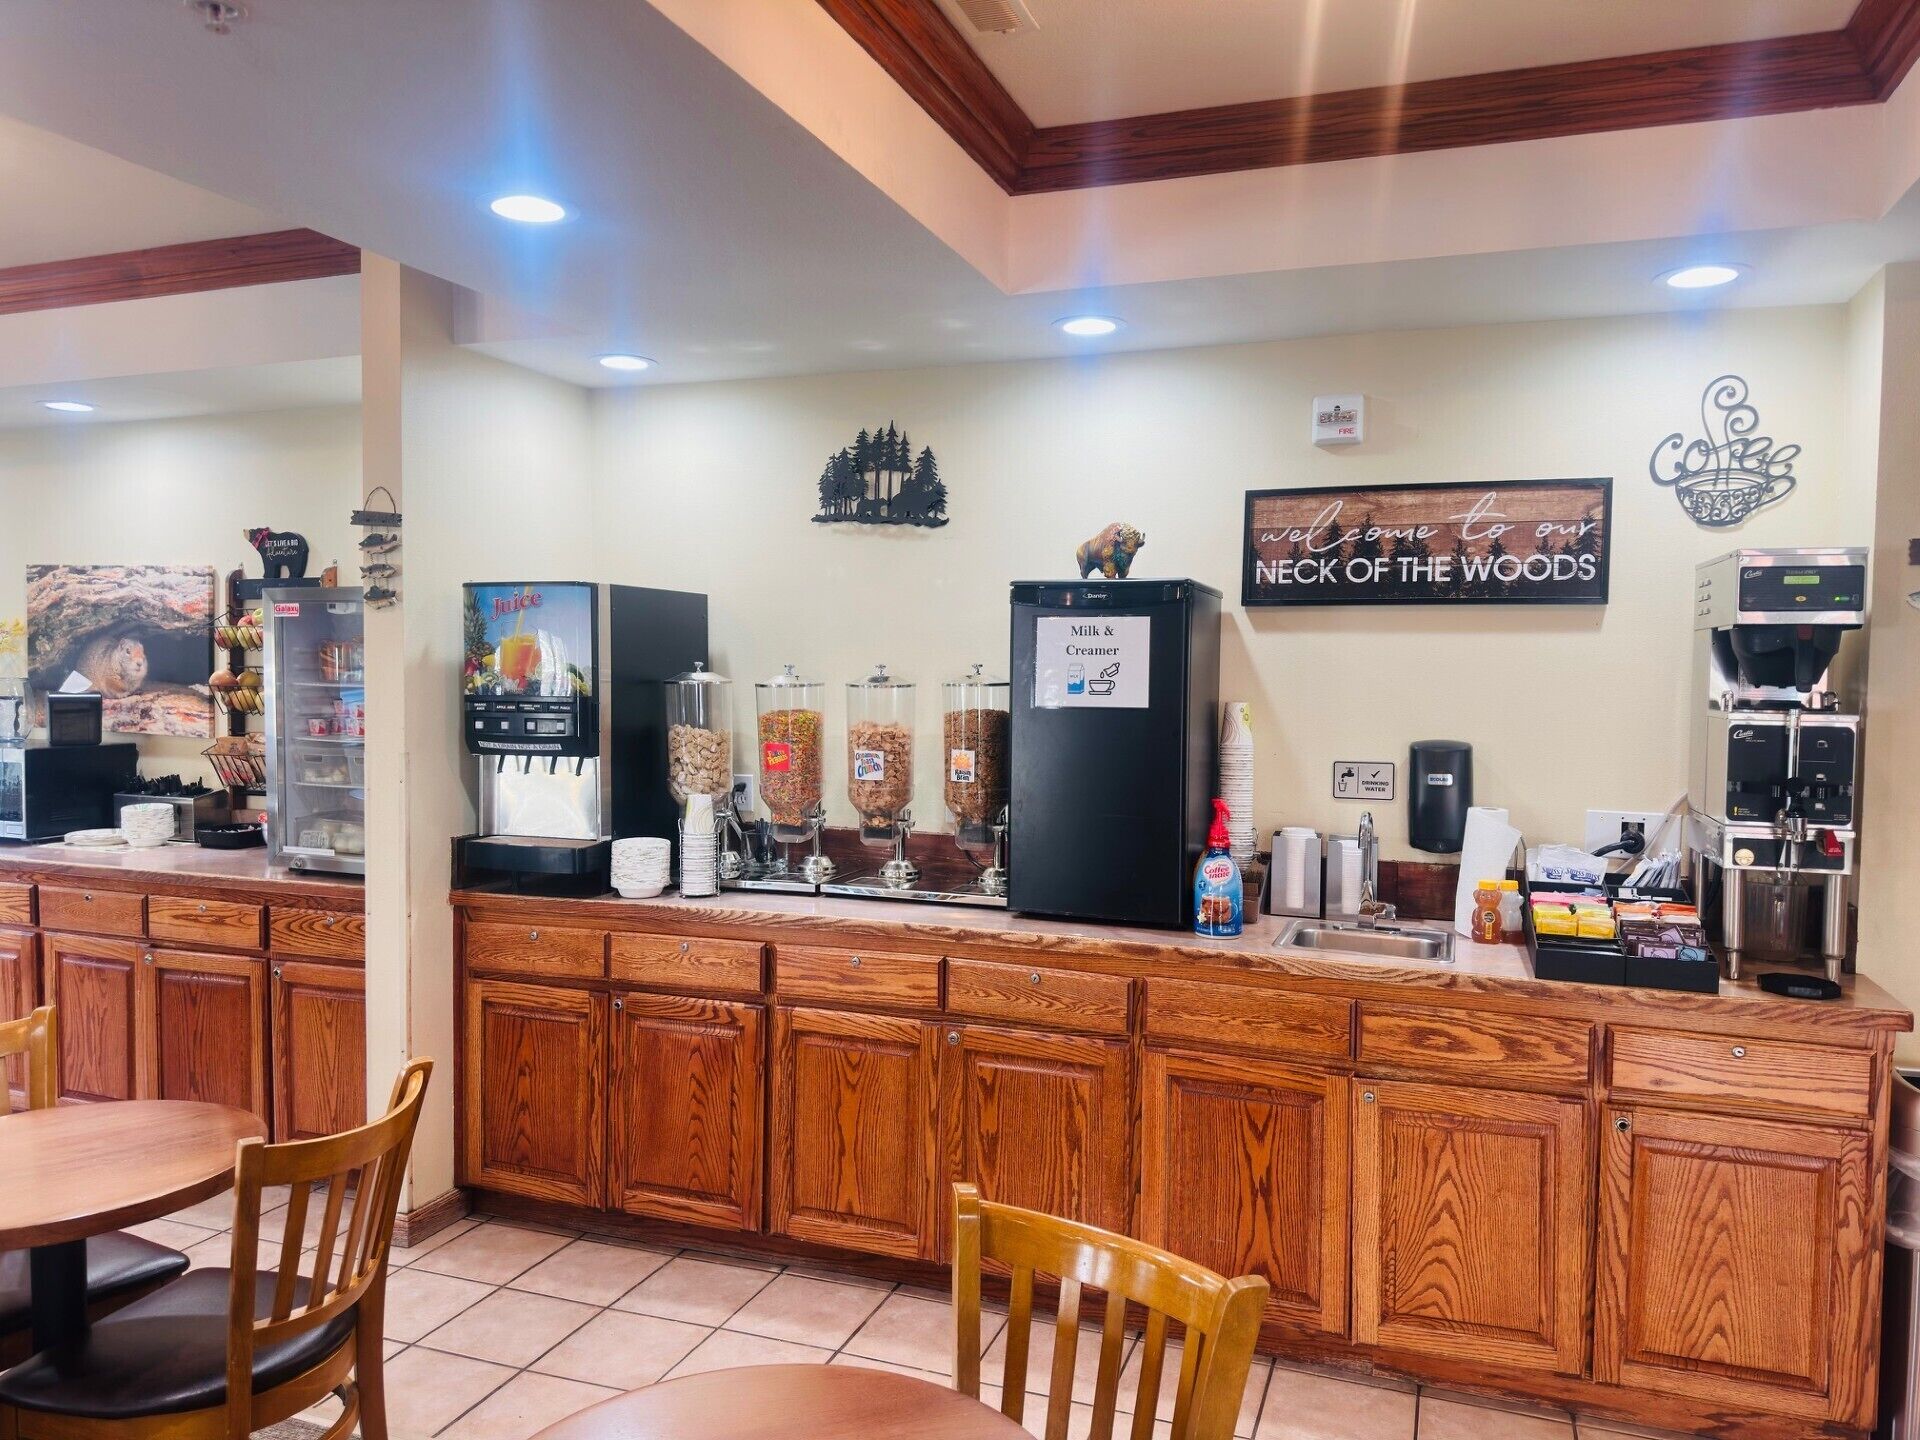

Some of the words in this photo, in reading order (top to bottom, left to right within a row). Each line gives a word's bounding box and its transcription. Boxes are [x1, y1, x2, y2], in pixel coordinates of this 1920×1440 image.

[1338, 427, 1355, 435] FIRE
[1261, 500, 1438, 552] welcome
[1449, 491, 1515, 540] to
[1535, 521, 1597, 538] our
[291, 539, 299, 547] BIG
[1255, 558, 1338, 584] NECK
[1345, 557, 1390, 583] OF
[1397, 555, 1451, 582] THE
[1460, 553, 1596, 581] WOODS
[275, 604, 298, 614] Galaxy
[491, 591, 544, 621] Juice
[1071, 625, 1100, 637] Milk
[1104, 625, 1114, 637] &
[1066, 644, 1120, 656] Creamer
[857, 763, 883, 778] Crunch
